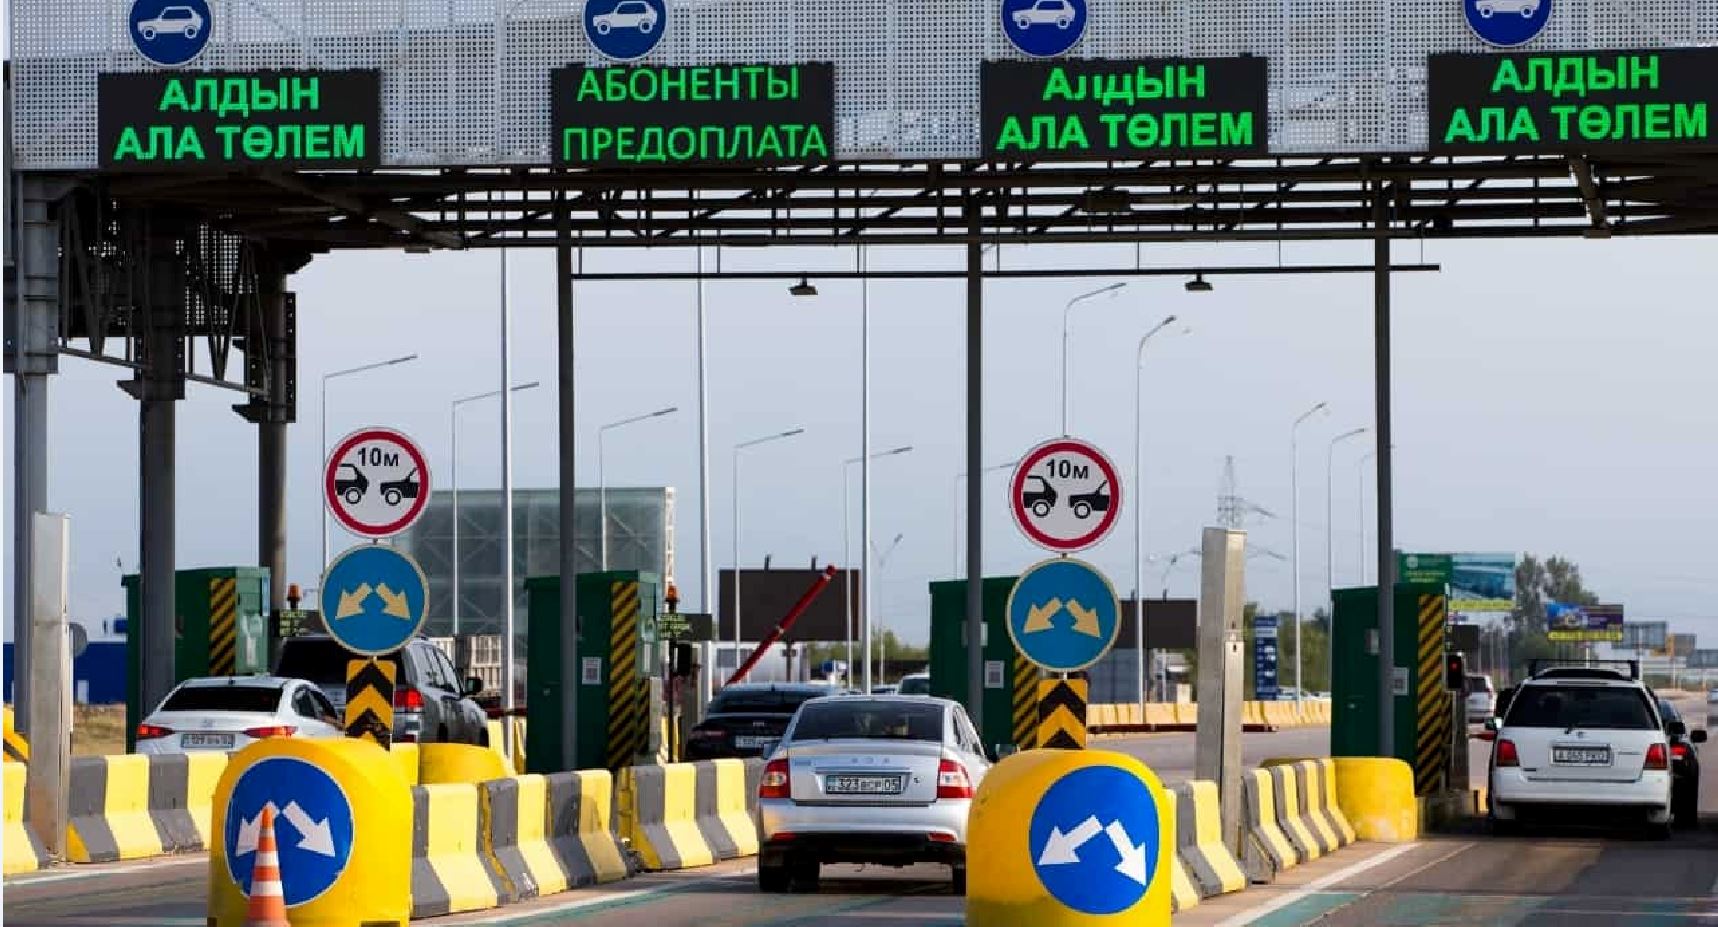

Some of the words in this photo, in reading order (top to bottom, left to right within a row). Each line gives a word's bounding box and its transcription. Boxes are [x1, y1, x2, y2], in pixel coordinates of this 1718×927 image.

[576, 66, 799, 102] АБОНЕНТЫ
[1491, 55, 1659, 98] АЛДЫН
[159, 77, 319, 118] АЛДЫН
[114, 126, 206, 161] АЛА
[215, 122, 365, 160] ТӨЛЕМ
[563, 124, 828, 162] ПРЕДОПЛАТА
[995, 115, 1090, 150] АЛА
[1099, 111, 1253, 149] ТӨЛЕМ
[1444, 105, 1540, 144] АЛА
[1550, 103, 1707, 141] ТӨЛЕМ
